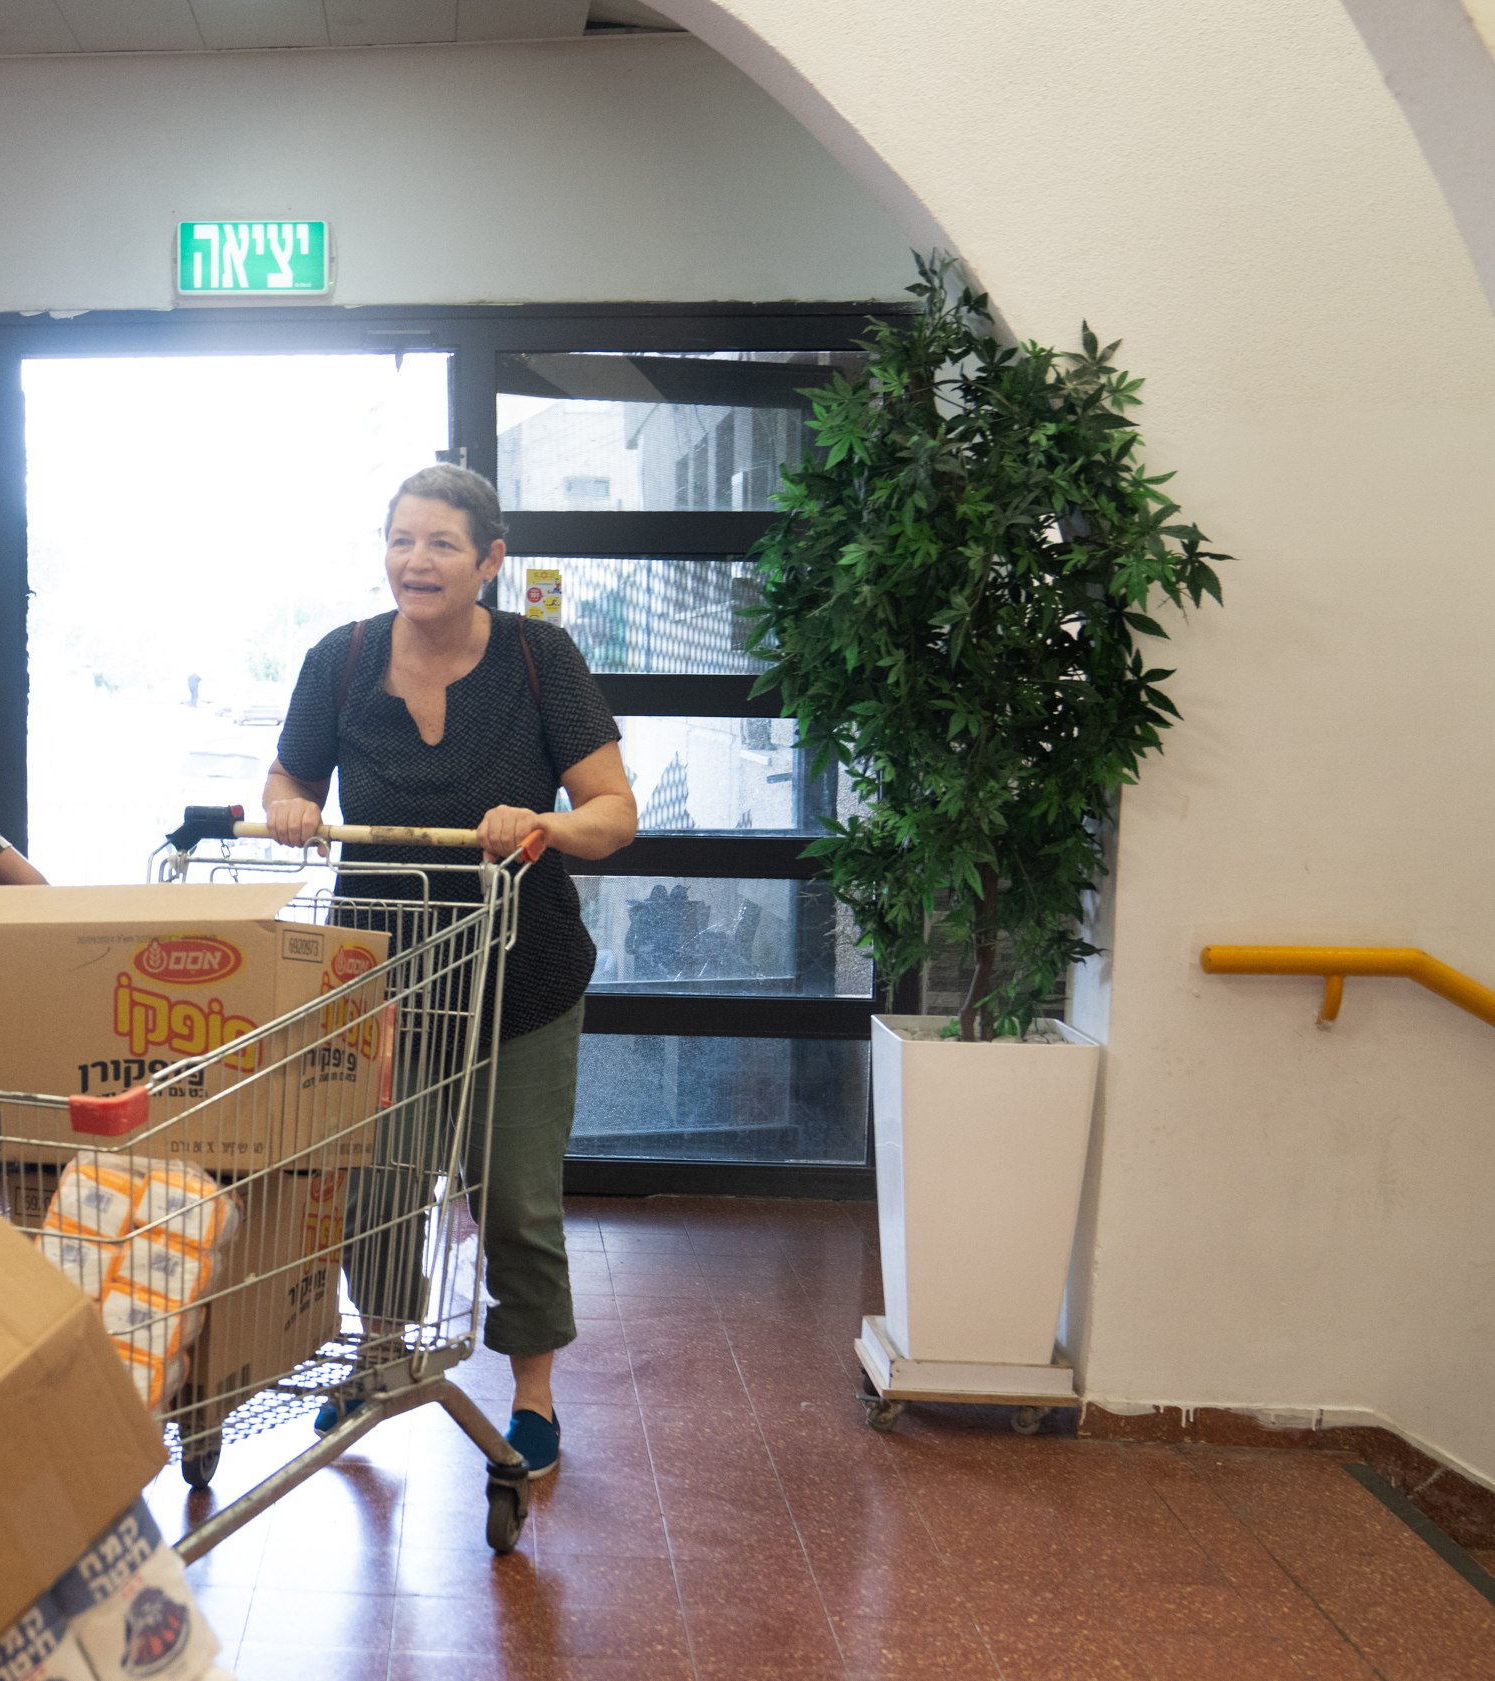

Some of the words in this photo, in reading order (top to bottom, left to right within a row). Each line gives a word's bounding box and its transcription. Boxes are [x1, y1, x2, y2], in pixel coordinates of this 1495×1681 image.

[193, 223, 309, 289] יציאה
[168, 951, 222, 971] אסם
[302, 1047, 357, 1076] פפקורן
[79, 1515, 139, 1580] קמח
